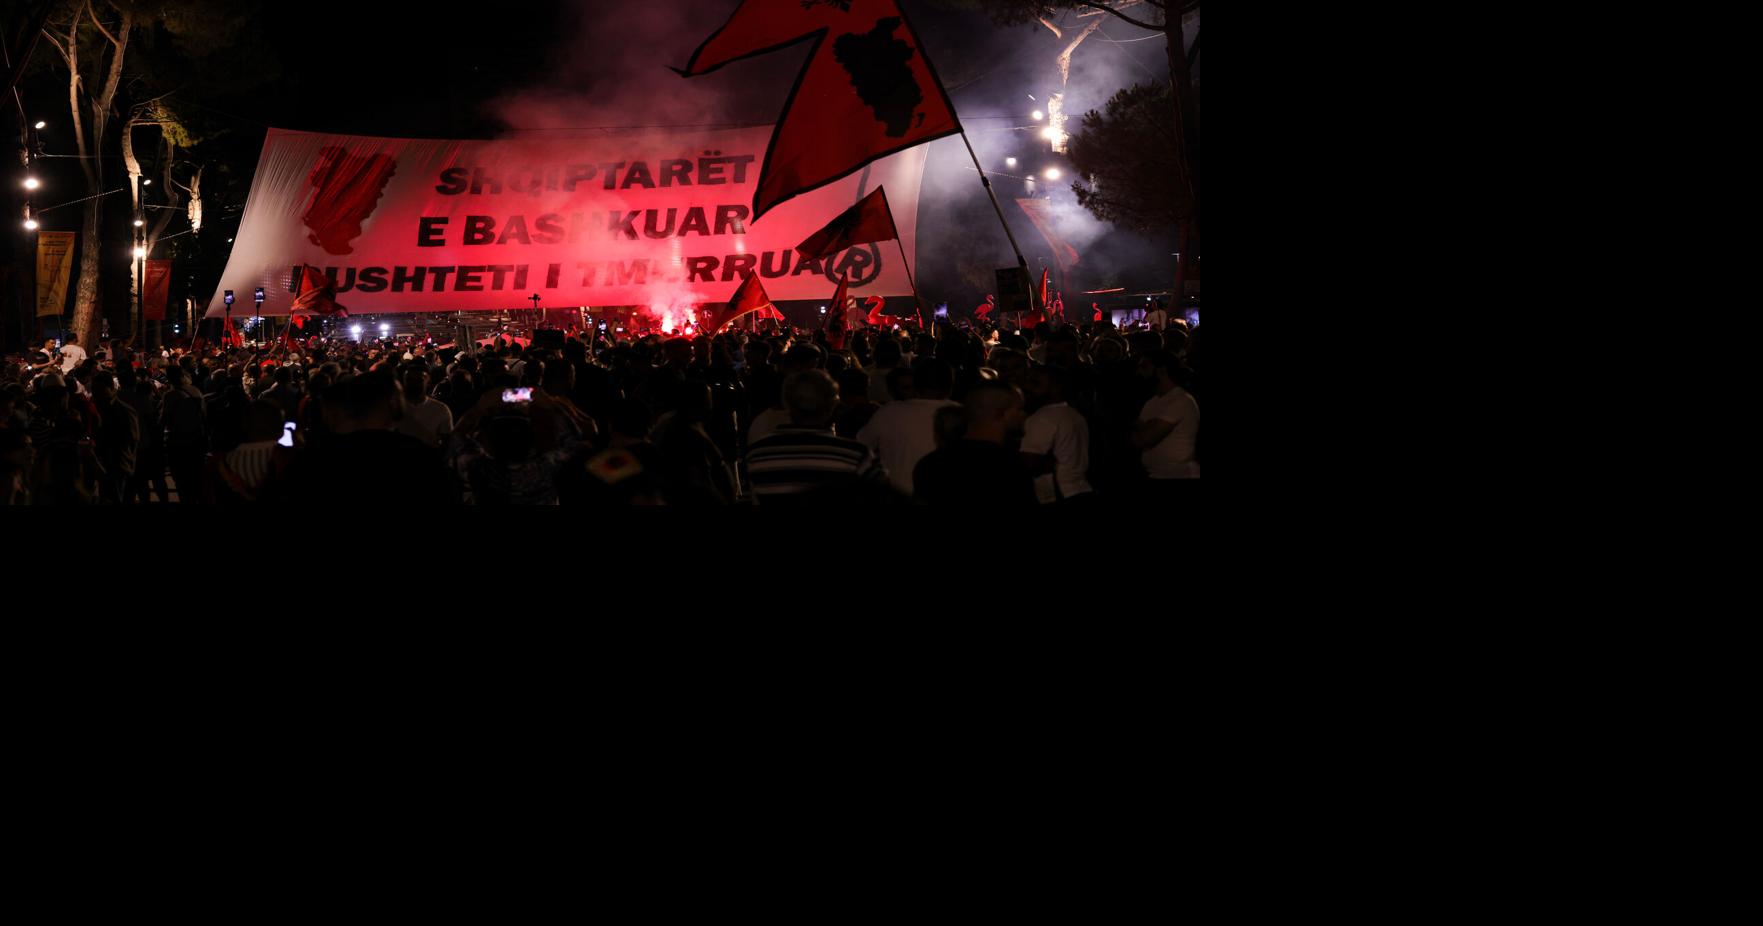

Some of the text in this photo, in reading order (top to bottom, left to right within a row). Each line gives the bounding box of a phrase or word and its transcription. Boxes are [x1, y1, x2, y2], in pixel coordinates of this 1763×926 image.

[435, 150, 755, 197] SHQIPTARËT
[417, 216, 449, 247] E
[545, 263, 561, 289] I
